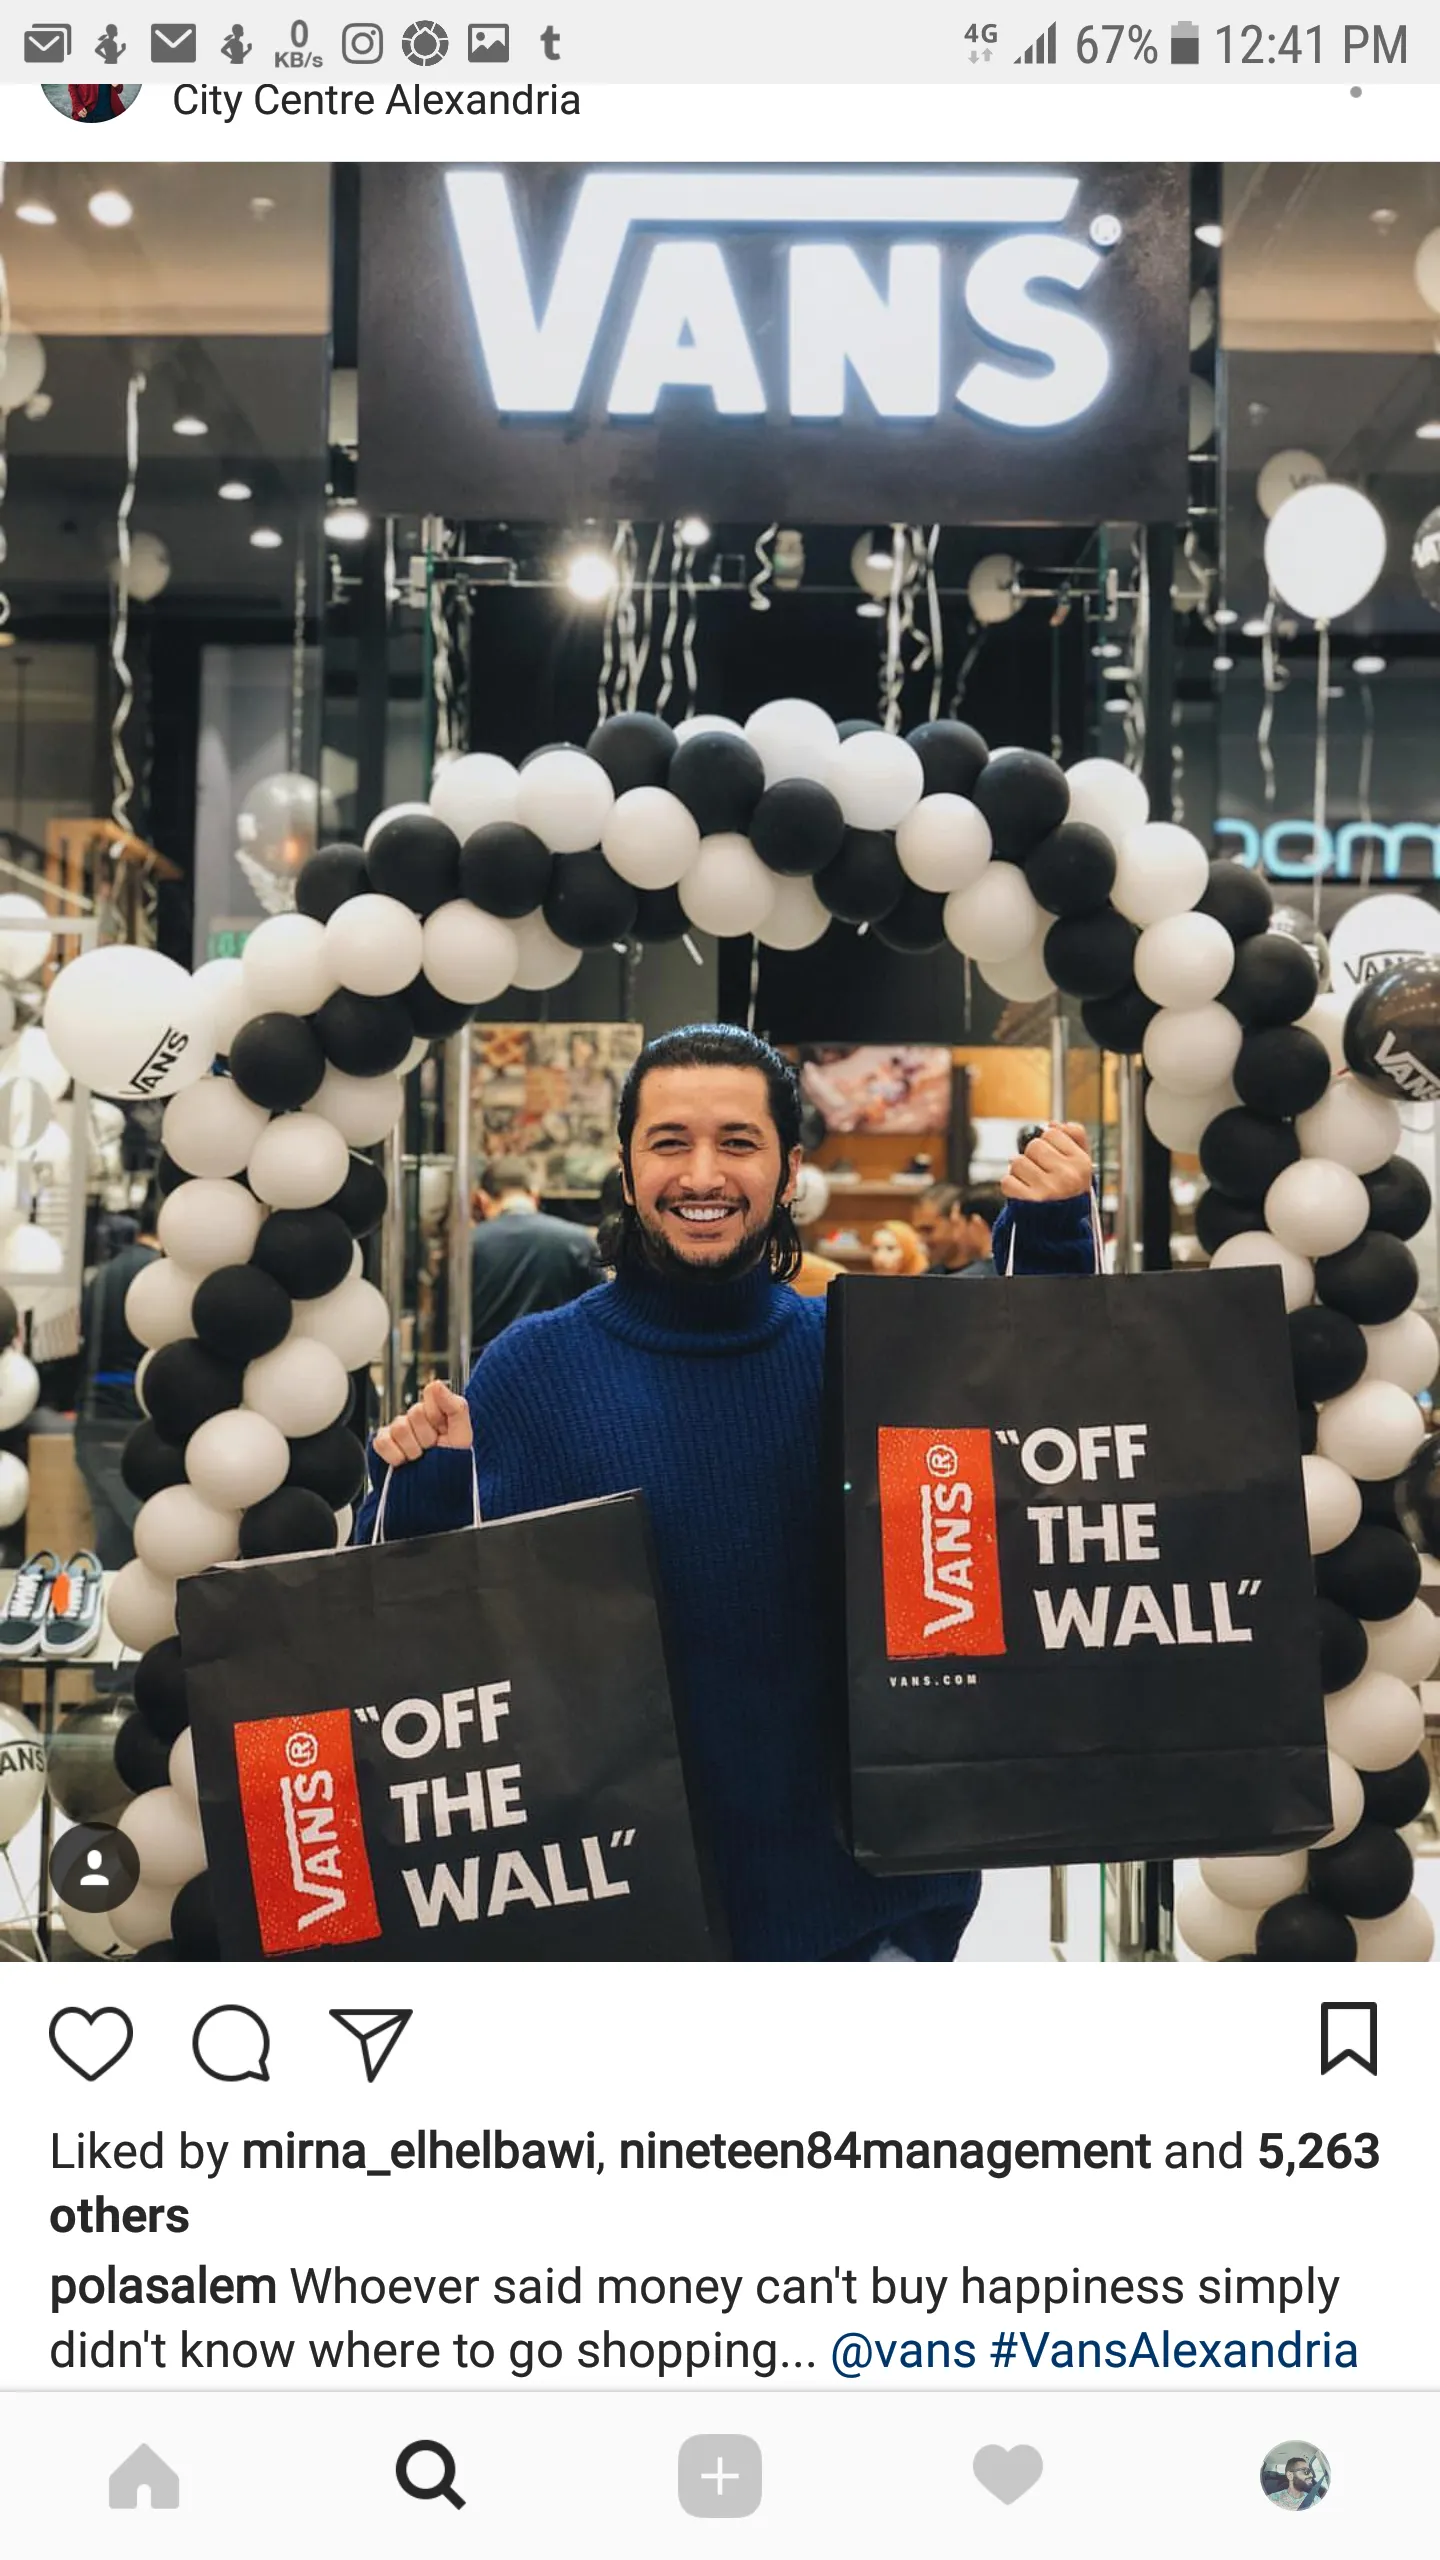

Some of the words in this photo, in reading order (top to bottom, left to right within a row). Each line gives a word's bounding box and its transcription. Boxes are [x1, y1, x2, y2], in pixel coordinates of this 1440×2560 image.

[119, 1026, 190, 1094] VANS
[1027, 1502, 1160, 1564] THE
[889, 1674, 977, 1687] VANS.COM
[390, 1763, 527, 1843] THE
